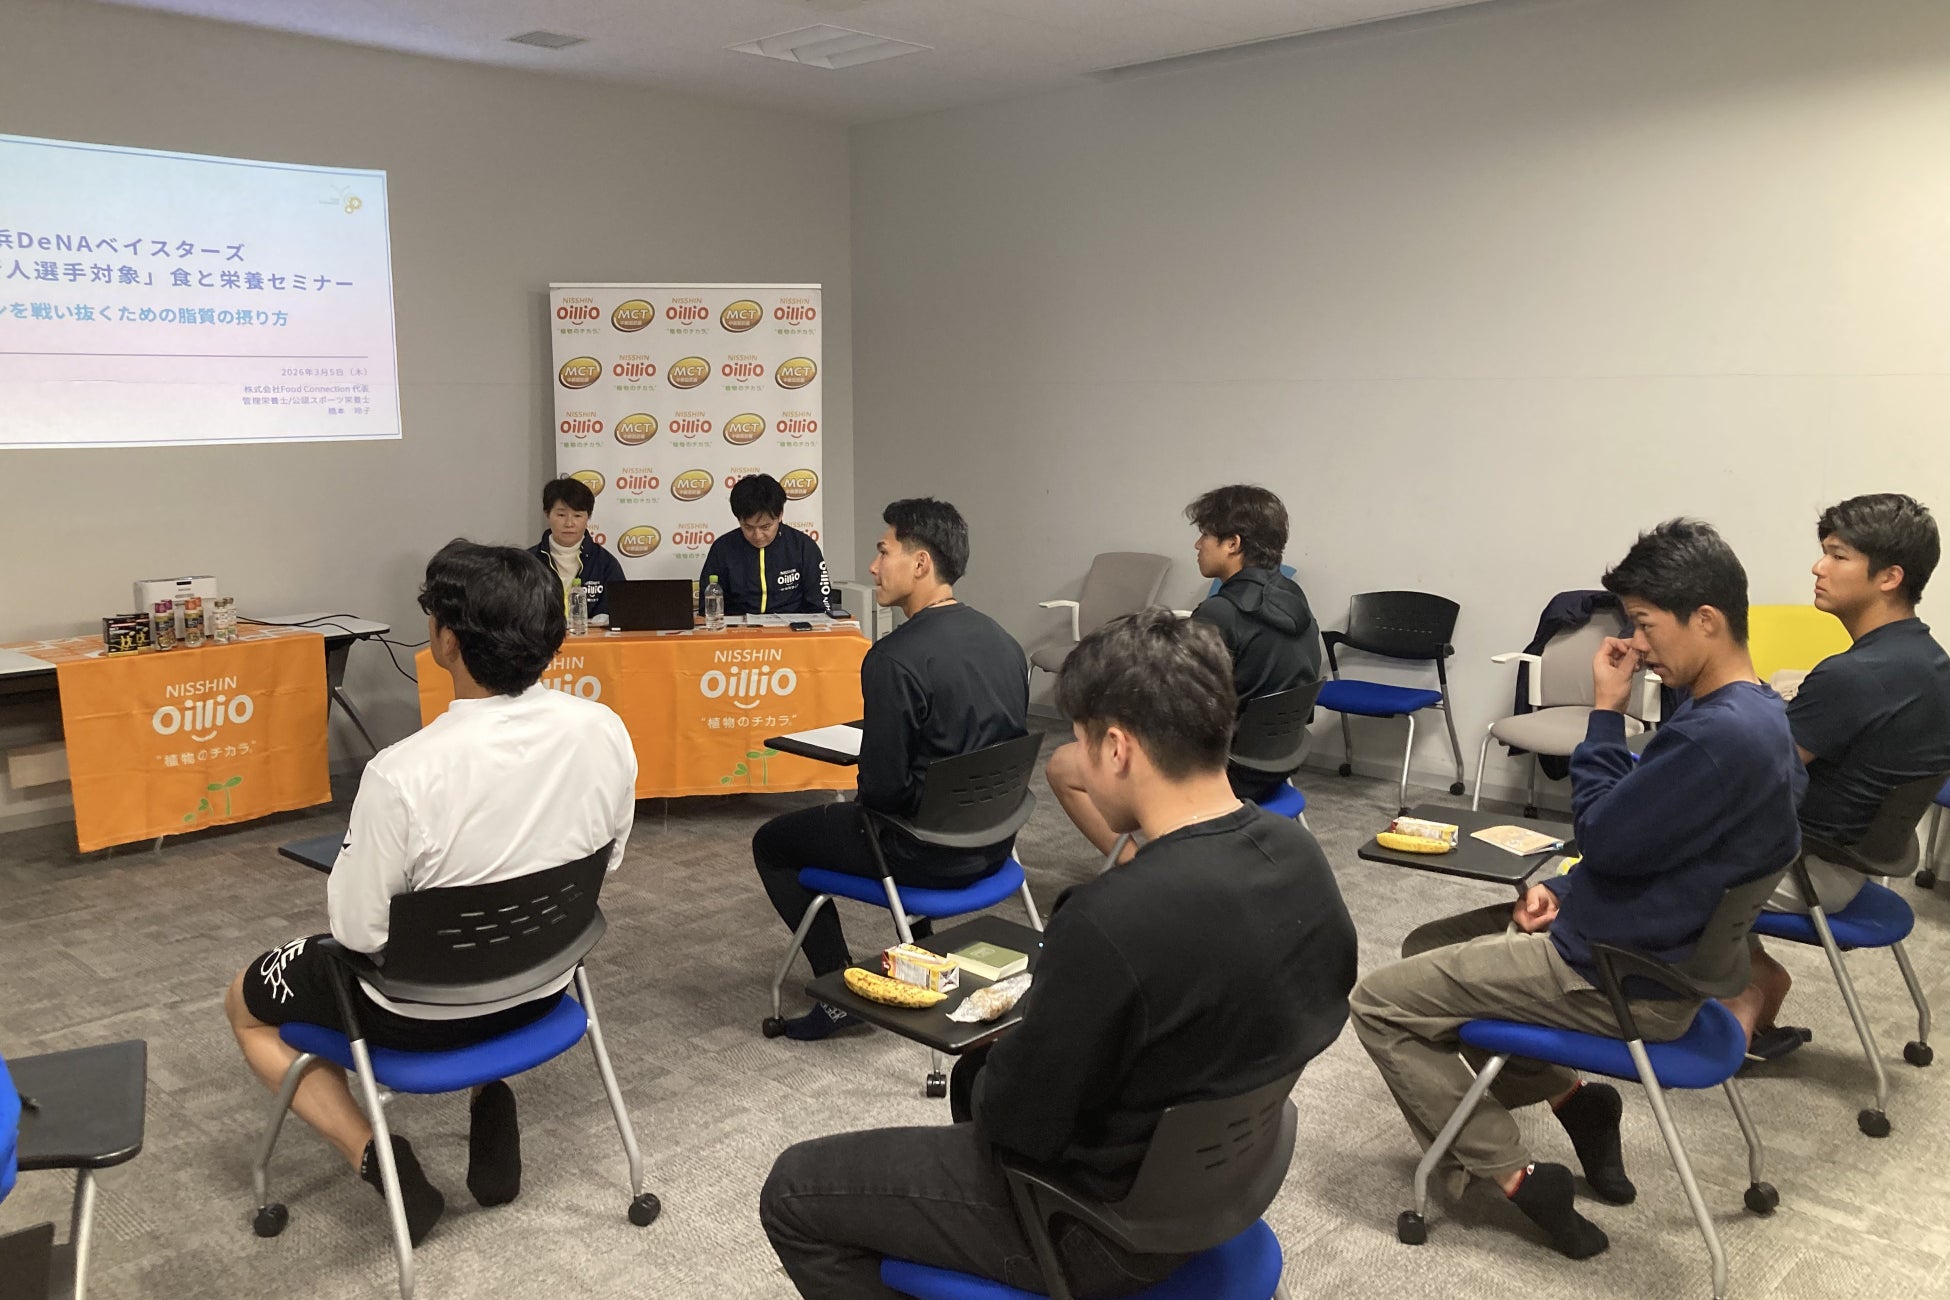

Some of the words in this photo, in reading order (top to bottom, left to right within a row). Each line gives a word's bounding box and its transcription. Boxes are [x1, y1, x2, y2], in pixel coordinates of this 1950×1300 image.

[0, 260, 354, 292] 人選手対象」食と栄養セミナー
[618, 309, 648, 319] MCT
[726, 310, 757, 319] MCT
[565, 366, 595, 376] MCT
[674, 366, 704, 376] MCT
[781, 367, 811, 376] MCT
[621, 423, 652, 433] MCT
[729, 423, 760, 433] MCT
[677, 479, 707, 489] MCT
[784, 478, 813, 488] MCT
[623, 535, 655, 545] MCT
[714, 648, 782, 663] NISSHIN
[166, 675, 237, 699] NISSHIN
